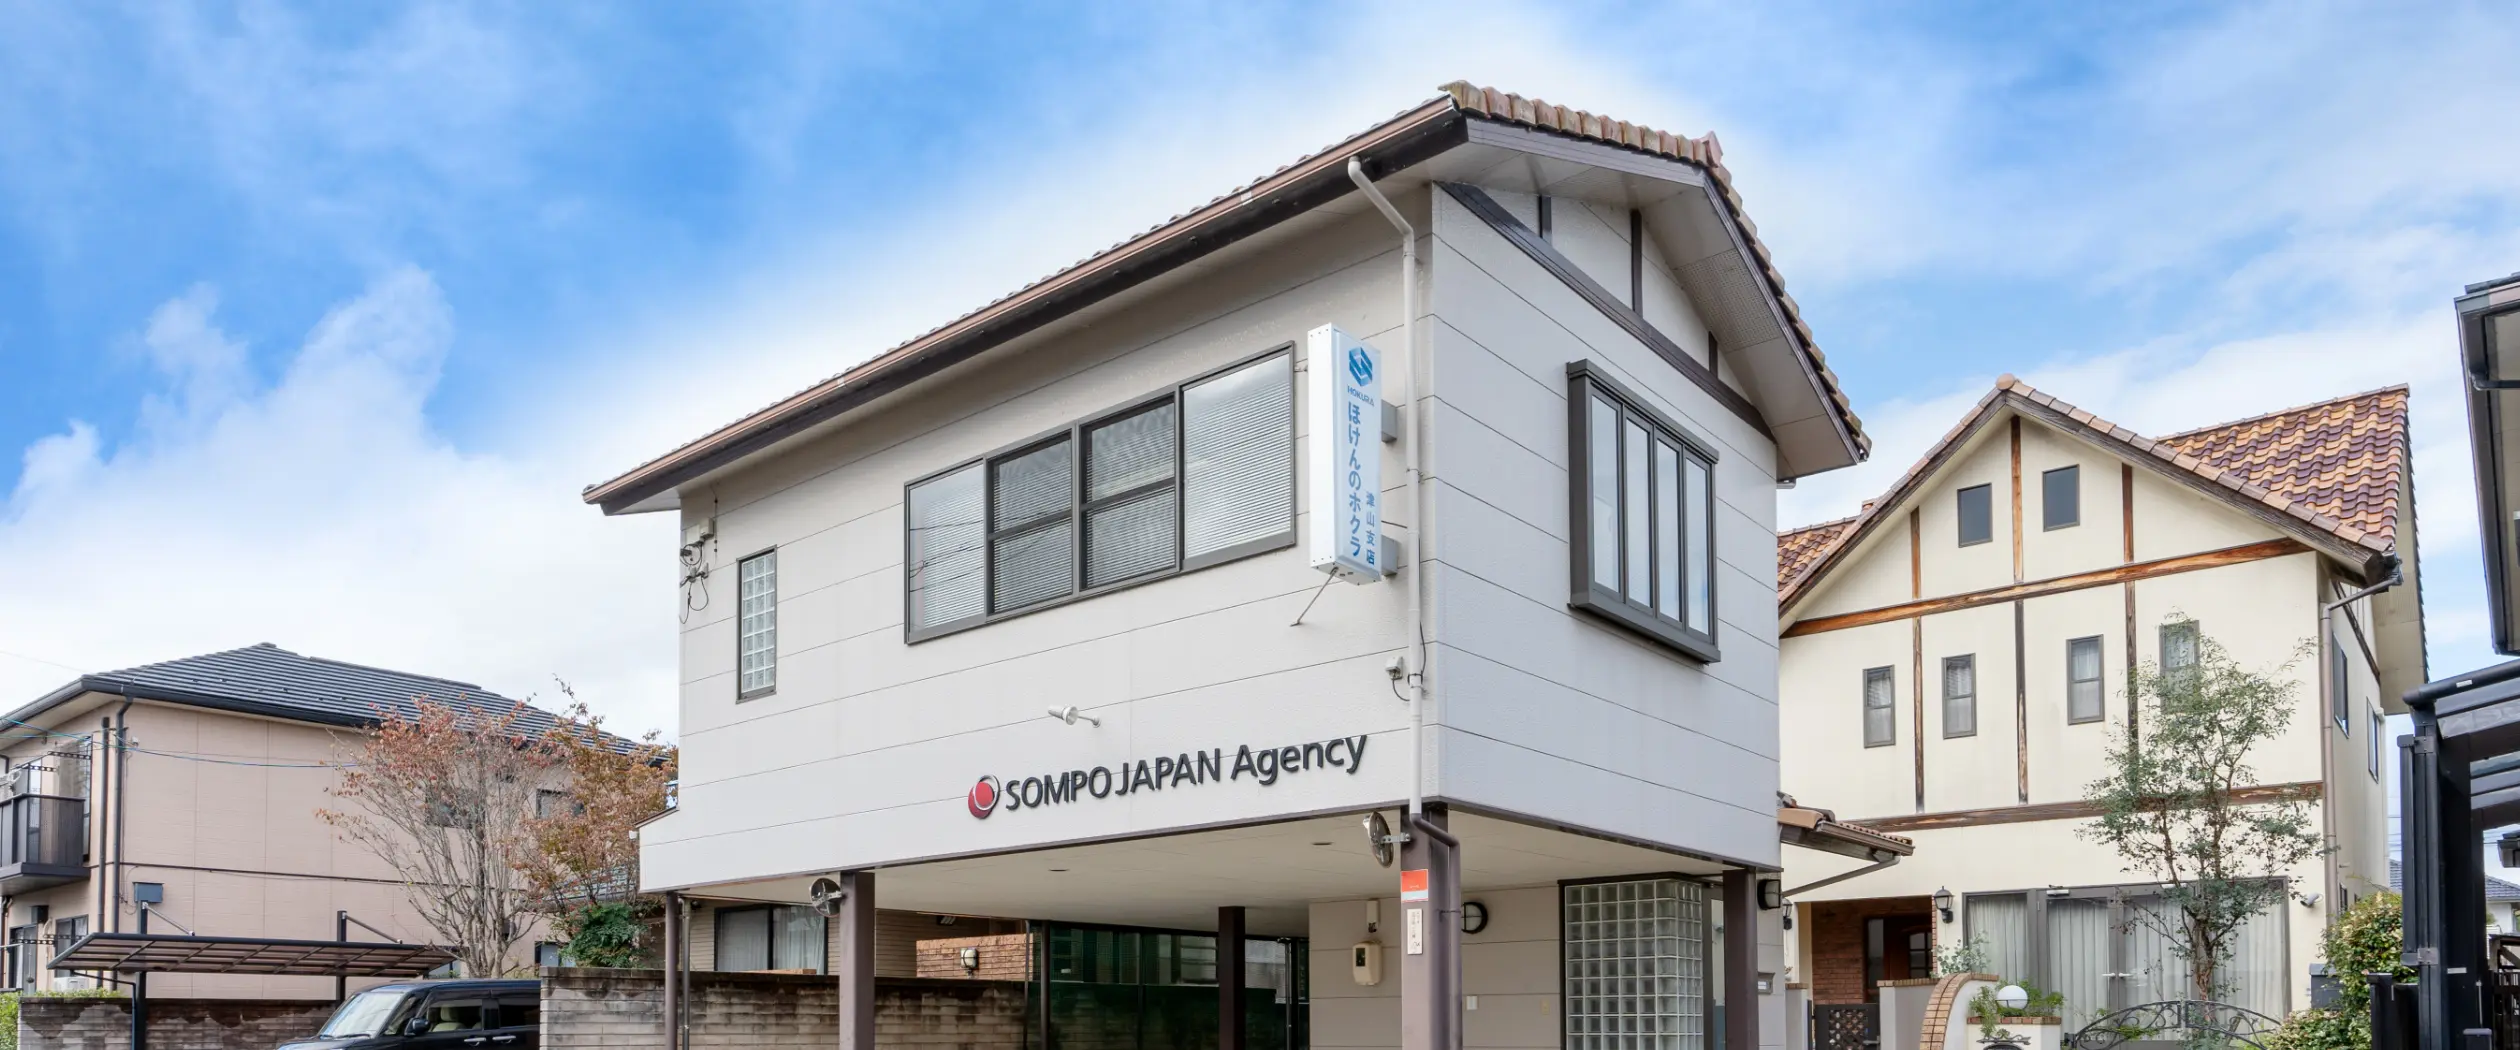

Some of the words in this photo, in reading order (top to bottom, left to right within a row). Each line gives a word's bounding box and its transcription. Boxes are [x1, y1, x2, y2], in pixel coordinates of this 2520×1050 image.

[1347, 384, 1374, 406] HOKURA
[1348, 401, 1361, 556] ほけんのホクラ
[1366, 491, 1375, 565] 津山支店
[1005, 766, 1111, 811] SOMPO
[1115, 747, 1221, 796] JAPAN
[1230, 734, 1368, 786] Agency
